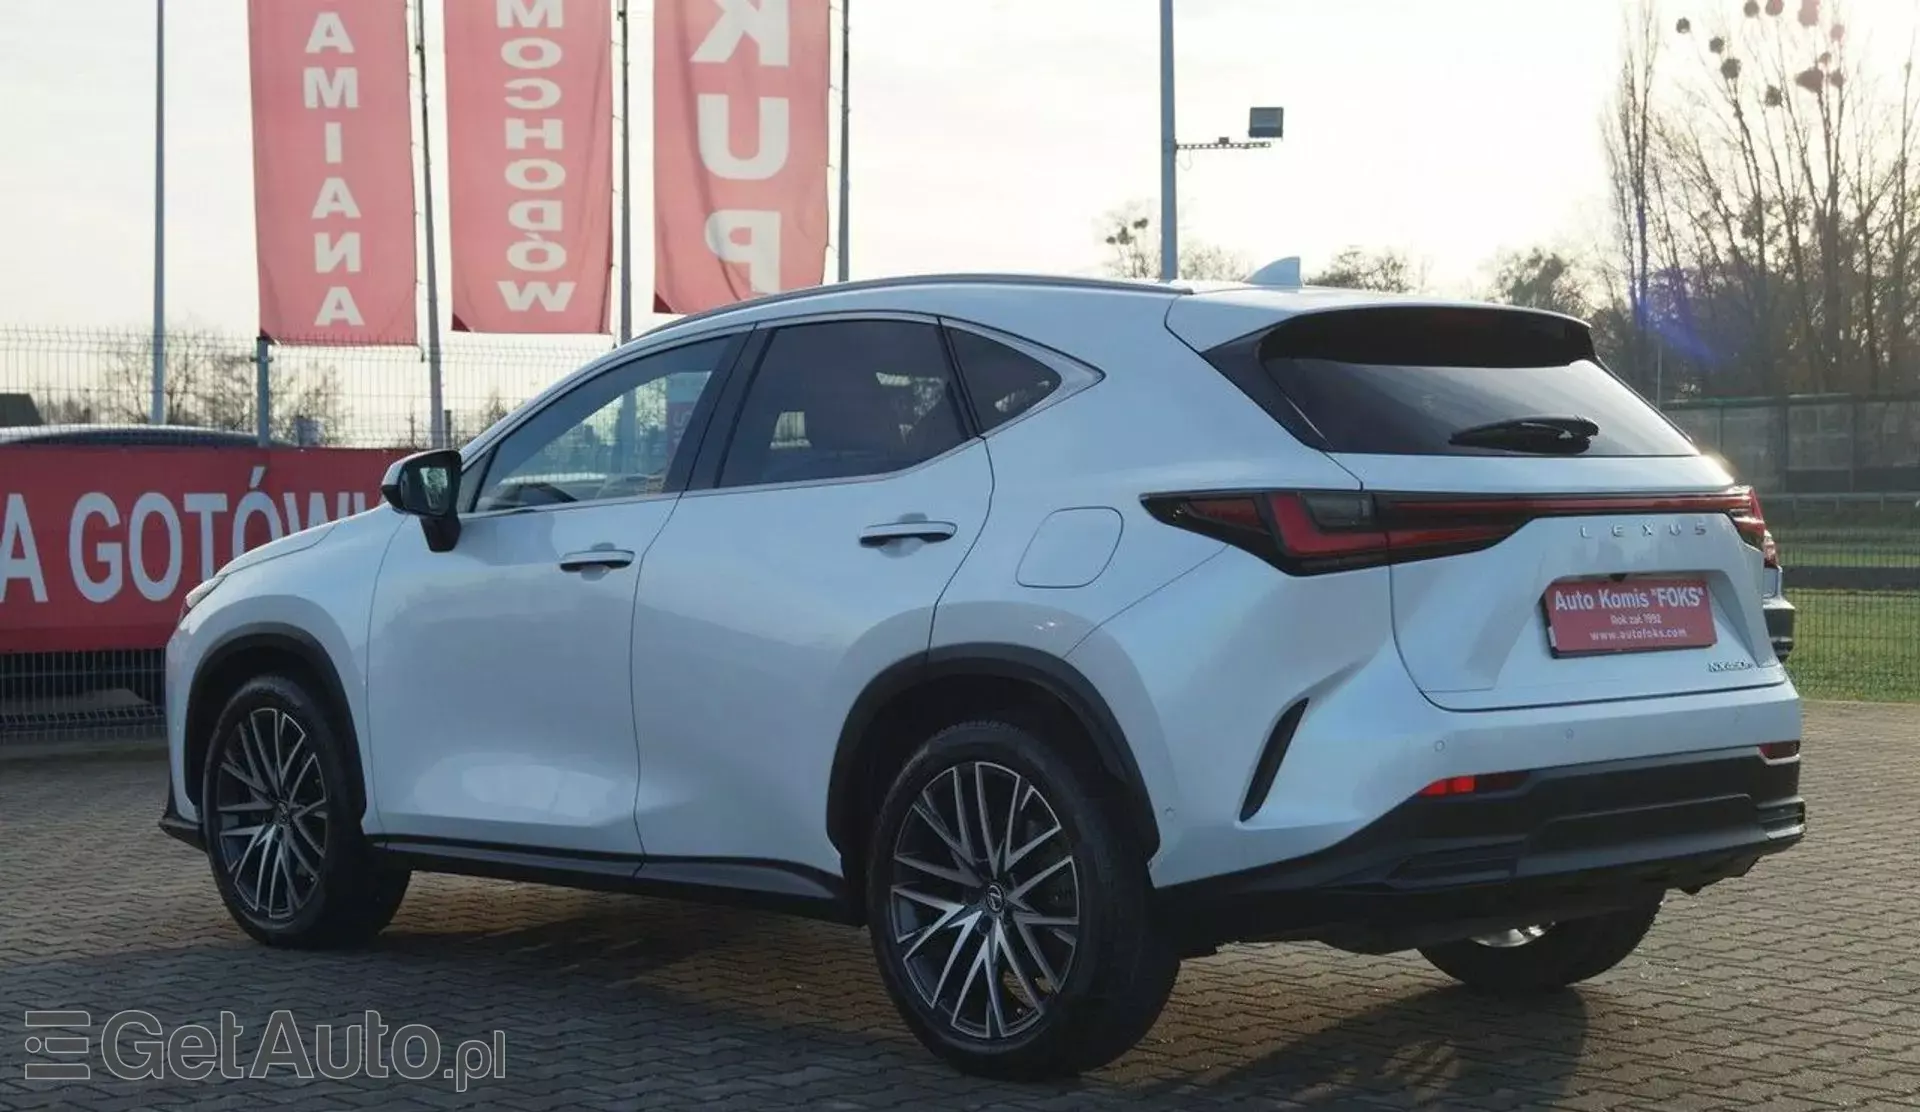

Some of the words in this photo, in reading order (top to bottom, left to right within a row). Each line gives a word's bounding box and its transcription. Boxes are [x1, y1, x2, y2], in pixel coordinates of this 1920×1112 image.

[1579, 523, 1707, 538] LEXUS
[0, 493, 48, 602] A
[1555, 589, 1594, 611] Auto
[1600, 588, 1650, 609] Komis
[1610, 614, 1627, 625] Rok
[1589, 627, 1688, 641] www.autofoks.com
